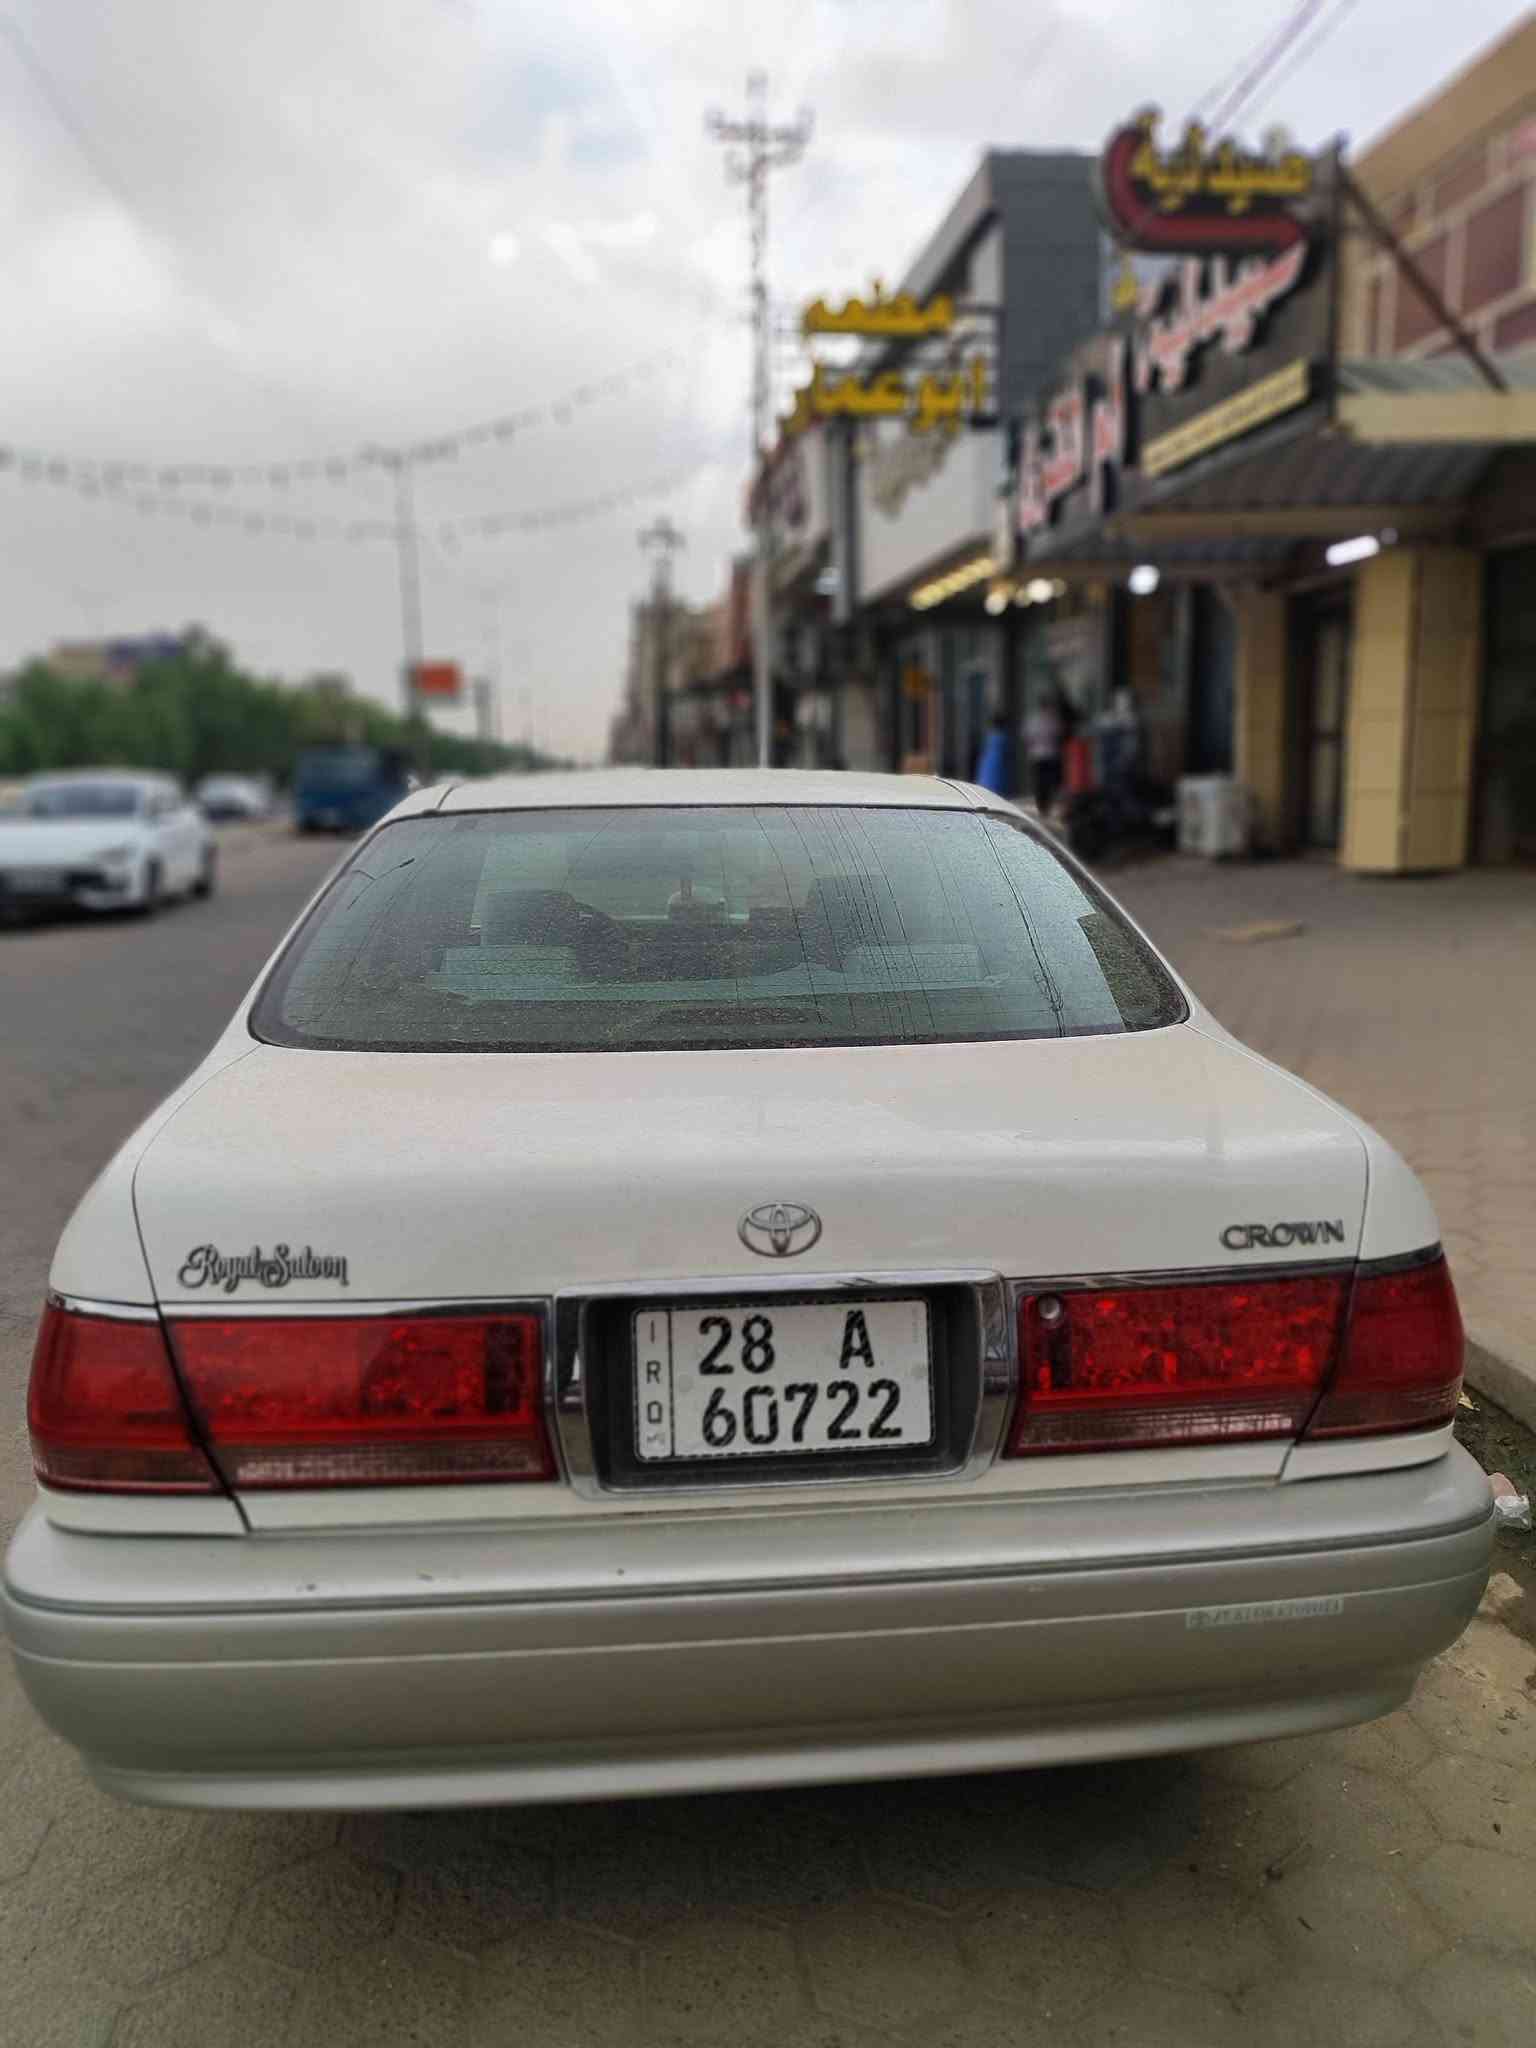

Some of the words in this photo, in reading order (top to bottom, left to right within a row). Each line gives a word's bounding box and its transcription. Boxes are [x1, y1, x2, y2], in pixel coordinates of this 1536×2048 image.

[1220, 1219, 1345, 1250] CROWN
[178, 1244, 262, 1294] Royal
[260, 1243, 350, 1288] Saloon
[699, 1315, 776, 1376] 28
[839, 1309, 875, 1370] A
[702, 1378, 903, 1447] 60722
